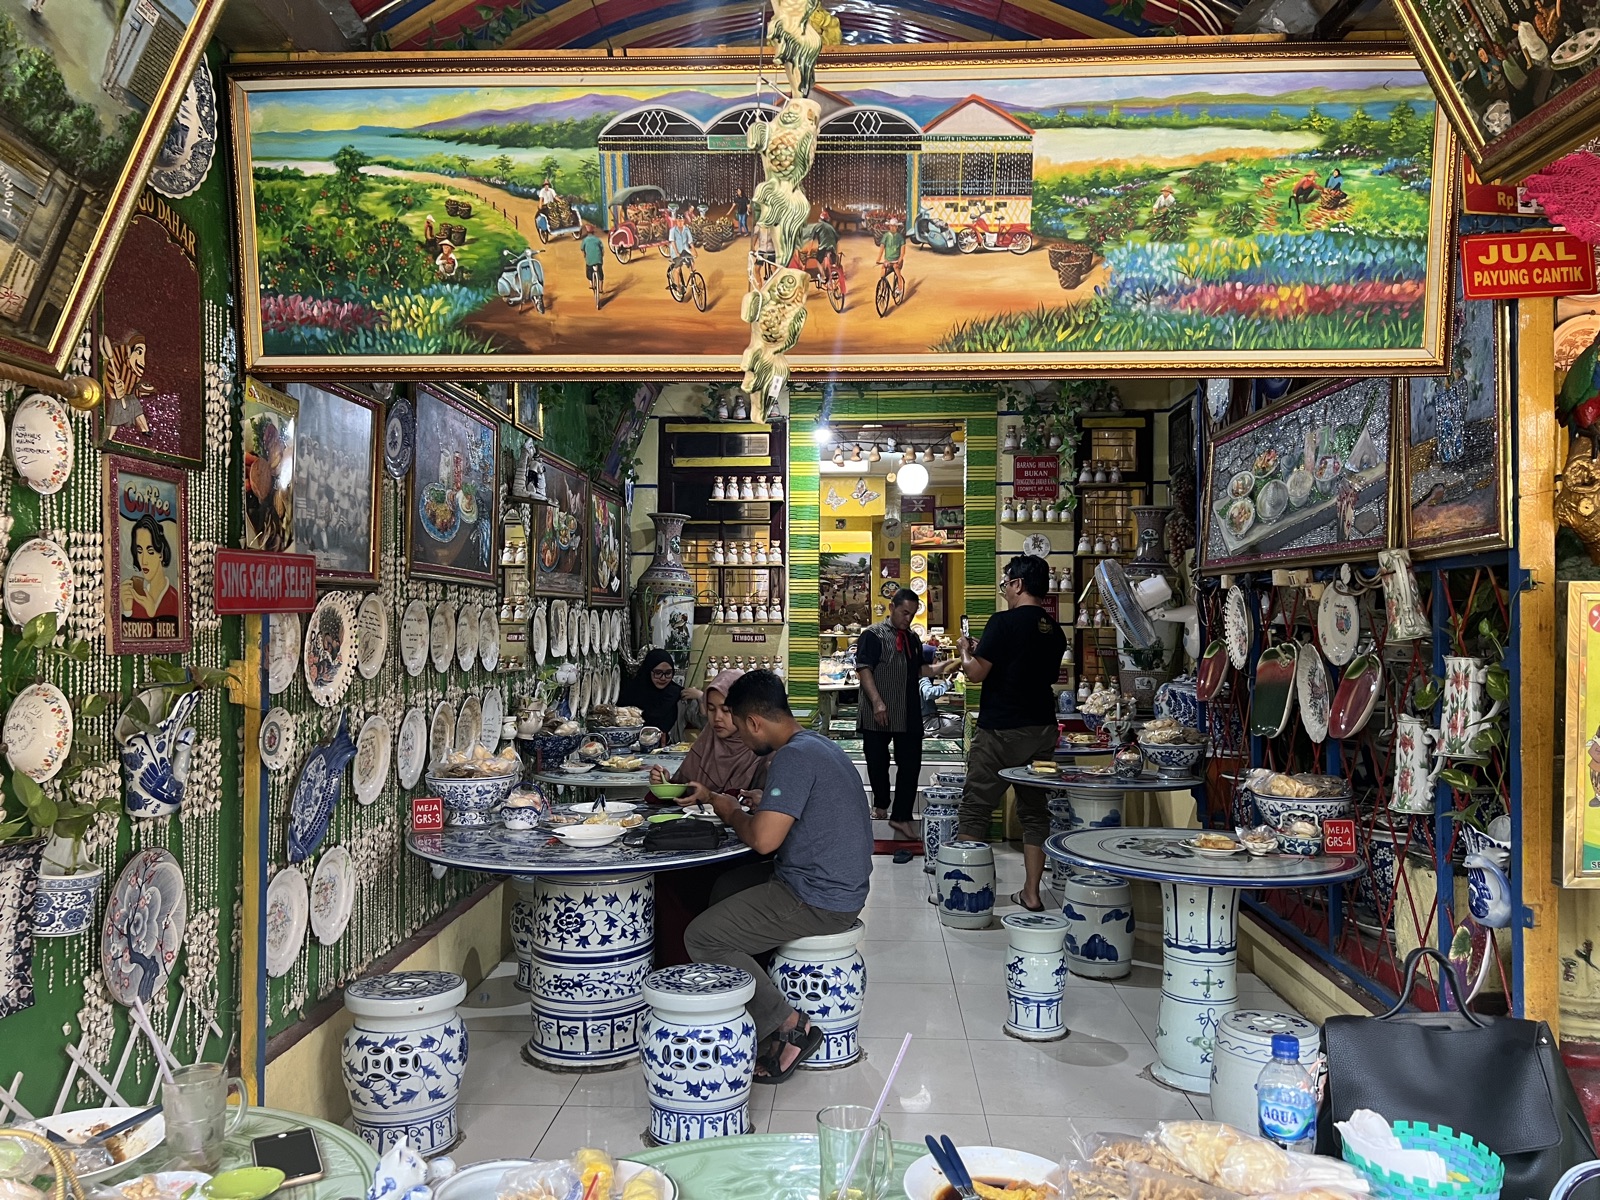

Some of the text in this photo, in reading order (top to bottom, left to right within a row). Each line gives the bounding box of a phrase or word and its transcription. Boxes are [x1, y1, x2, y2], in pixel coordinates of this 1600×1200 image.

[157, 197, 196, 257] DAHAR
[1478, 241, 1577, 265] JUAL
[1474, 266, 1584, 287] PAYUNG CANTIK
[1016, 461, 1057, 469] BARANG HILANG
[123, 480, 171, 518] Coffee
[221, 562, 312, 601] SING SALAH SELEH
[122, 621, 176, 638] SERVED HERE
[734, 634, 765, 642] TEMBOK KIRI
[416, 804, 439, 812] MEJA
[415, 813, 441, 824] GRS-3
[1327, 826, 1350, 835] MEJA
[1326, 836, 1352, 847] GRS-4
[1263, 1106, 1299, 1126] AQUA
